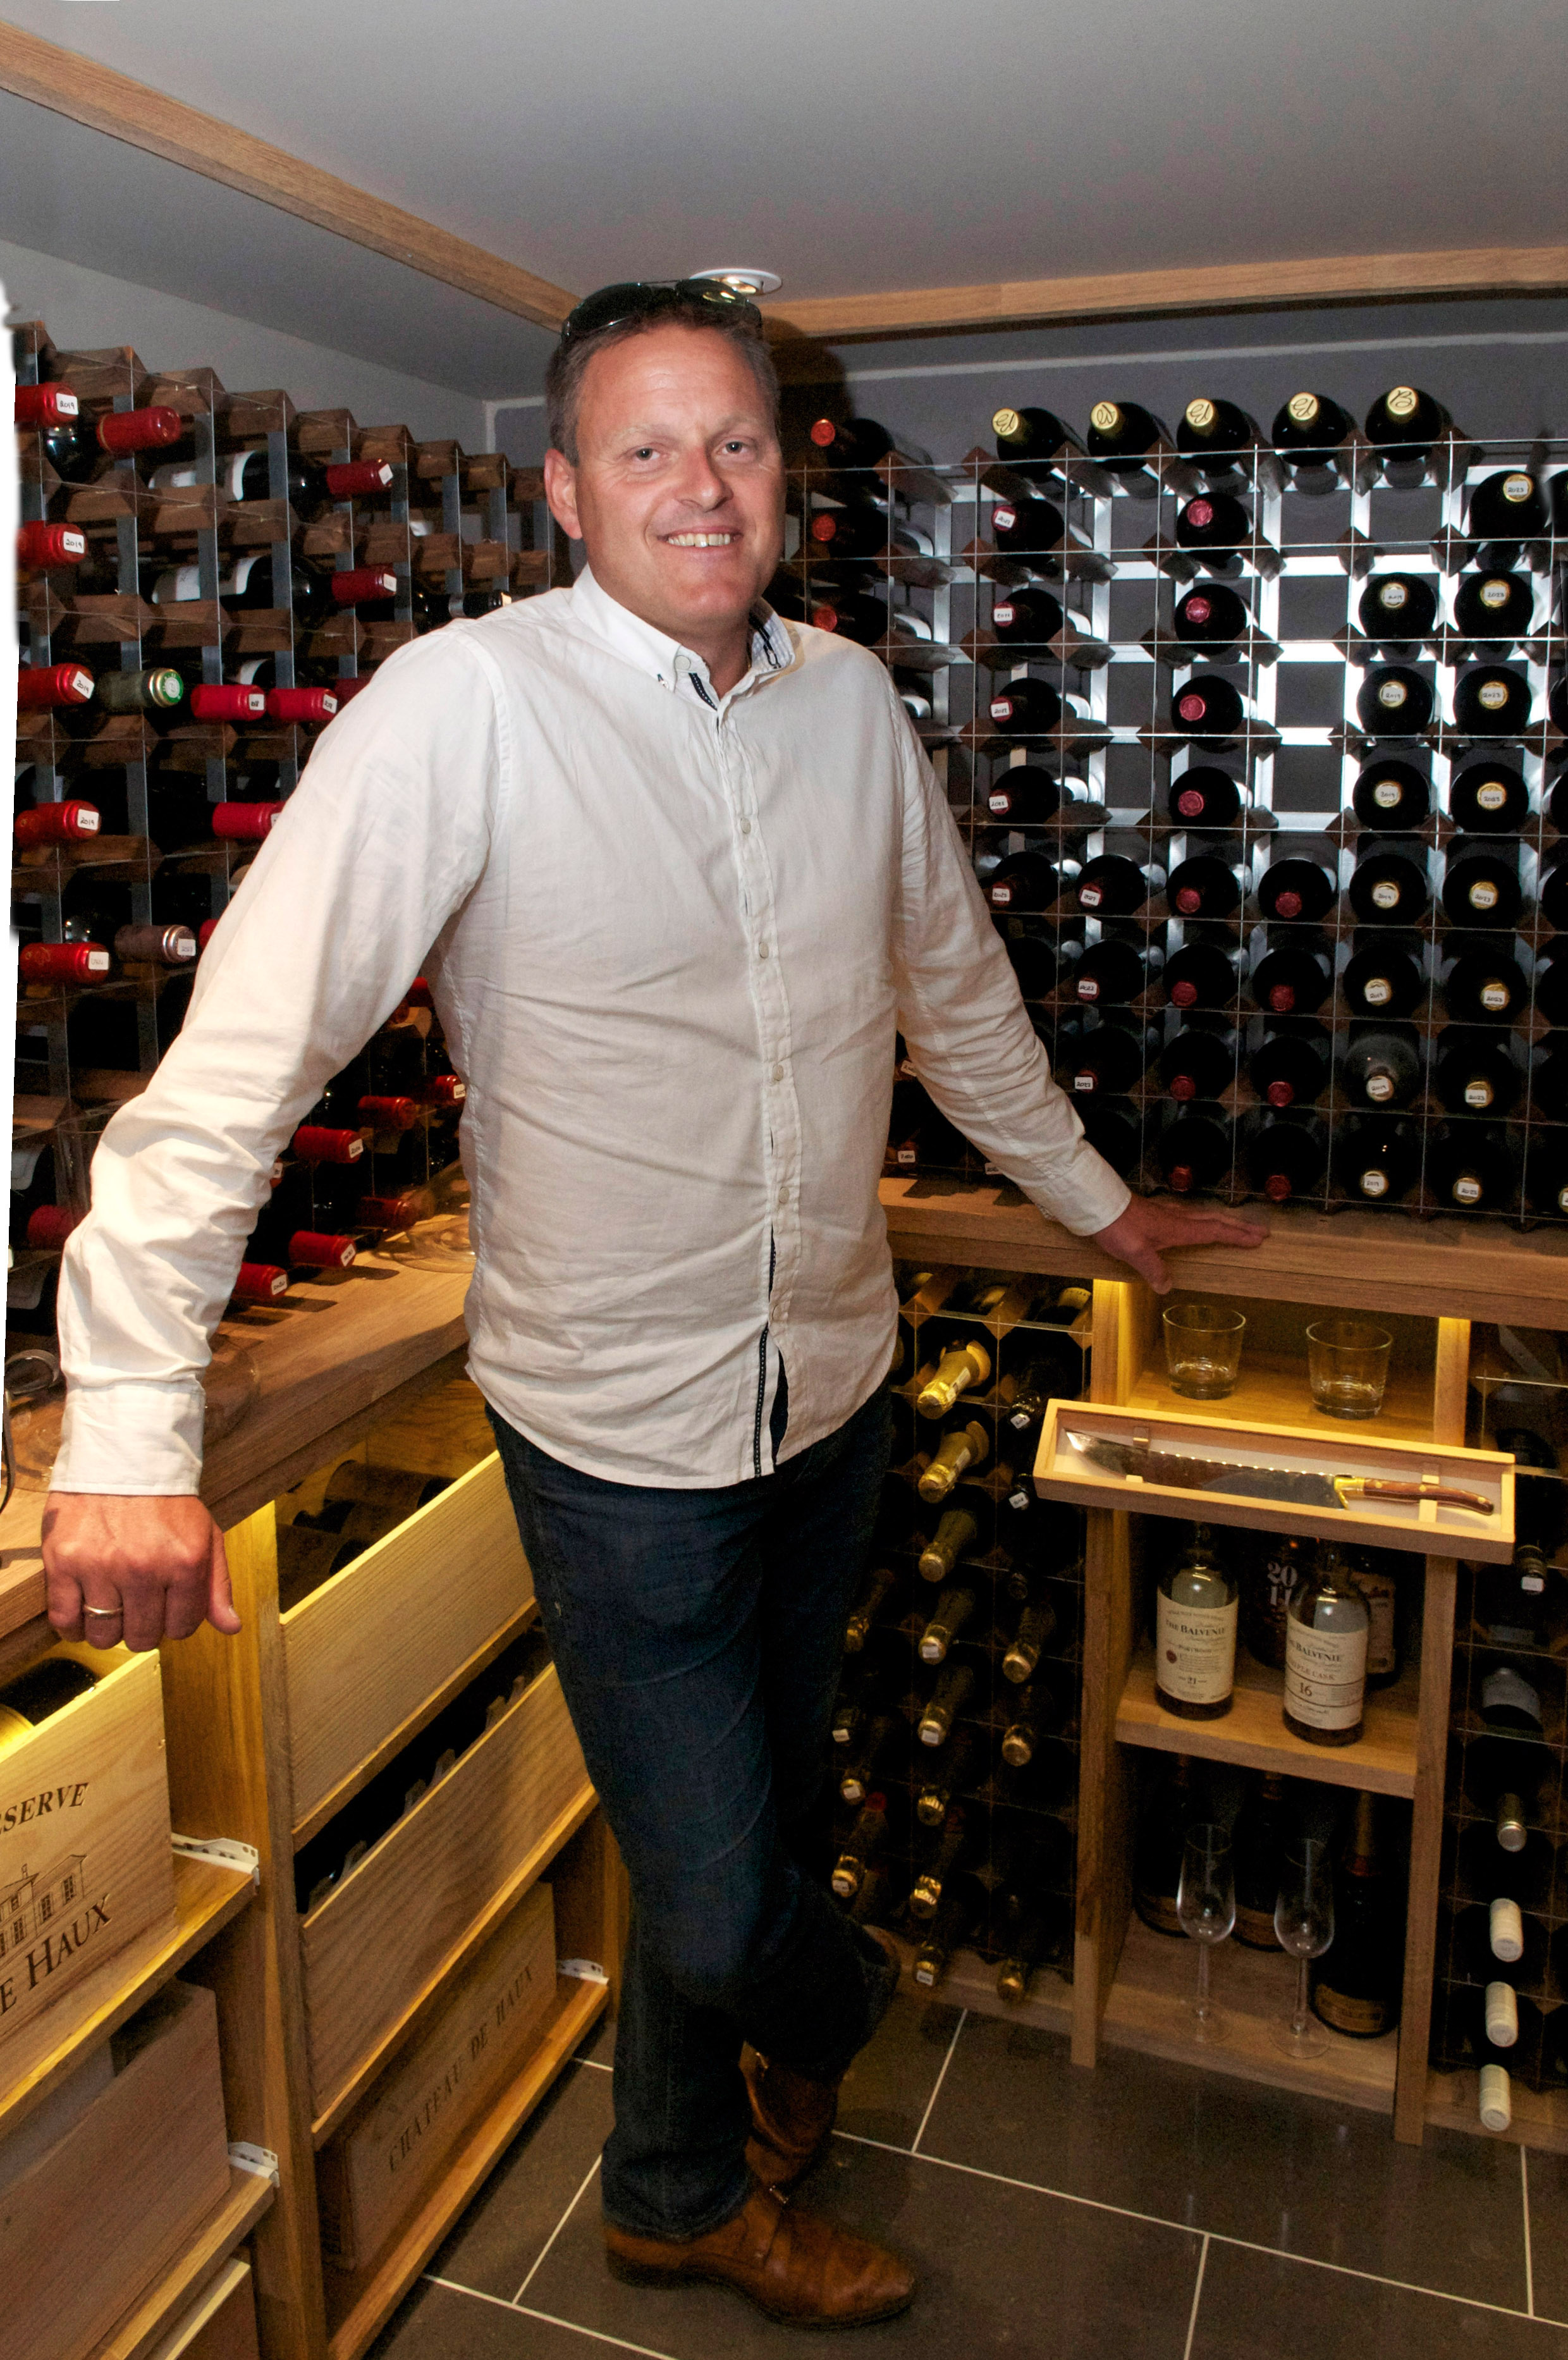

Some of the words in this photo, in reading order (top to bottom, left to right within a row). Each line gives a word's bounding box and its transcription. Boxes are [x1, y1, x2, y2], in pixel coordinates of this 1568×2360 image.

[59, 401, 75, 410] 2019
[65, 538, 82, 548] 2019
[77, 679, 89, 692] 2019
[80, 816, 95, 826] 2019
[1474, 894, 1491, 902] 2023
[1181, 1625, 1225, 1636] BALVENIE
[1296, 1642, 1341, 1662] BALVENIE
[1299, 1681, 1313, 1697] 16
[0, 1782, 89, 1835] SERVE
[25, 1896, 111, 1991] HAUX
